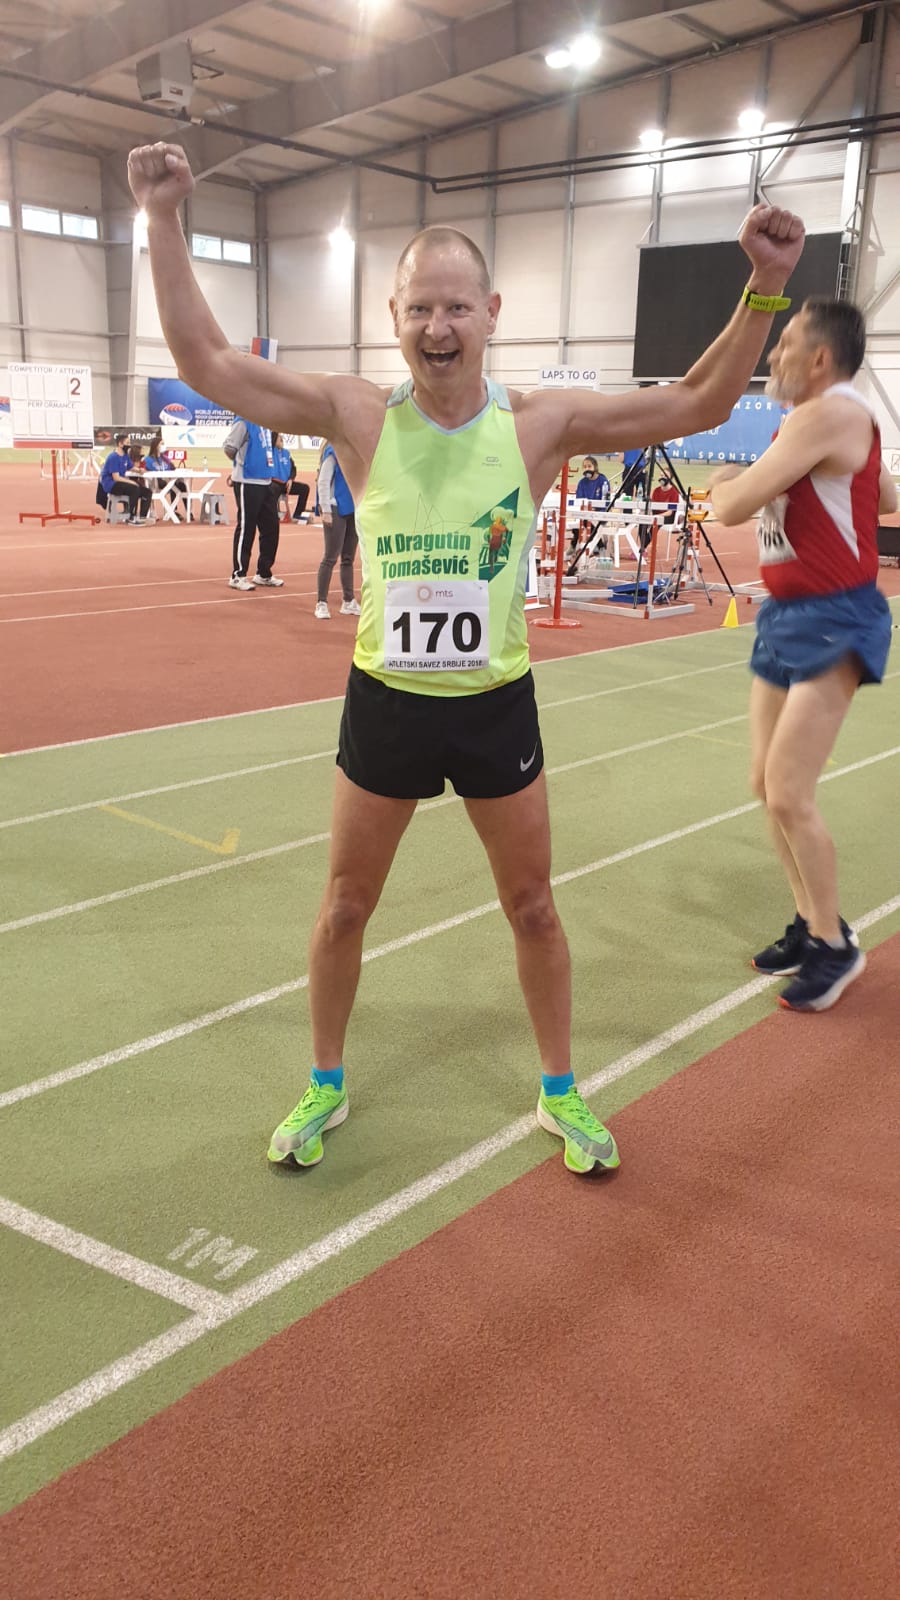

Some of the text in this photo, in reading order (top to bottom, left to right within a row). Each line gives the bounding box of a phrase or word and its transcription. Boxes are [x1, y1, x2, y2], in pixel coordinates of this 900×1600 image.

[9, 364, 53, 374] COMPETITOR
[59, 367, 89, 375] ATTEMPT
[542, 370, 597, 380] LAPS TO GO
[70, 377, 81, 396] 2
[27, 400, 75, 409] PERFORMANCE
[113, 432, 157, 440] CTRADE
[698, 451, 757, 461] SPONZO
[376, 531, 471, 556] AK Dragutin
[381, 554, 469, 579] Tomašević
[435, 590, 454, 598] mts
[392, 611, 482, 654] 170
[388, 660, 418, 668] ATLETSKI
[442, 660, 466, 668] SRBIJE
